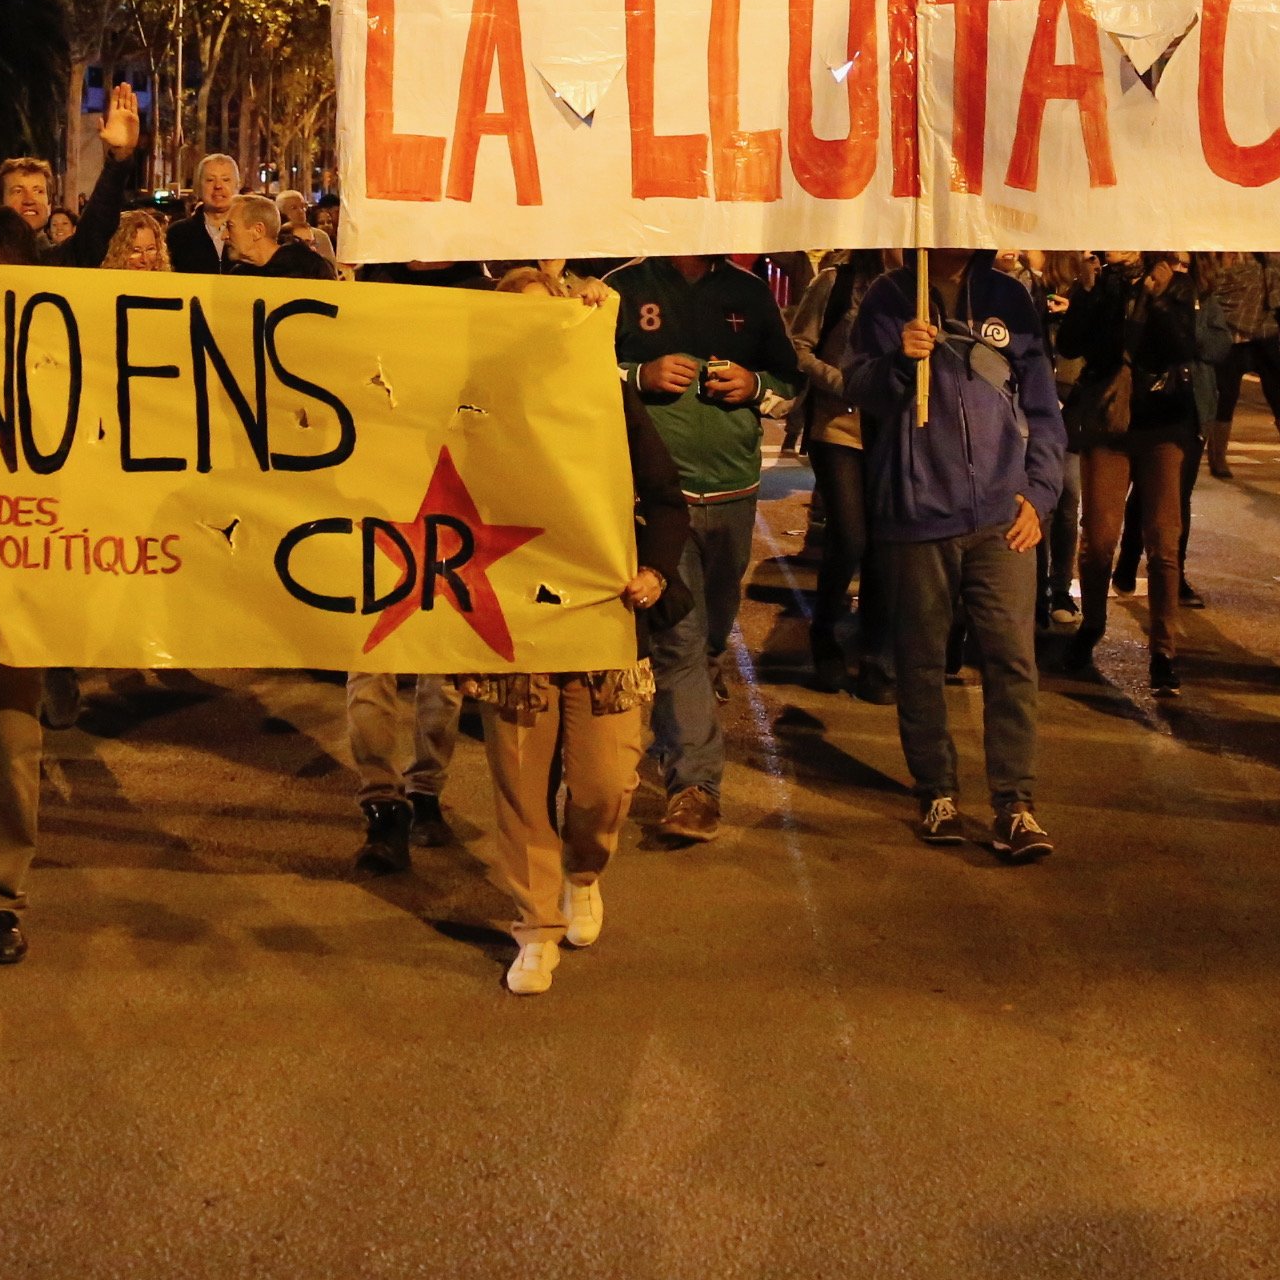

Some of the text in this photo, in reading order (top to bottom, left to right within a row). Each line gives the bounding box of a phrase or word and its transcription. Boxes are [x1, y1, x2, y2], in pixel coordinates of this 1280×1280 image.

[640, 303, 661, 331] 8
[116, 294, 356, 474] ENS
[273, 513, 476, 615] CDR
